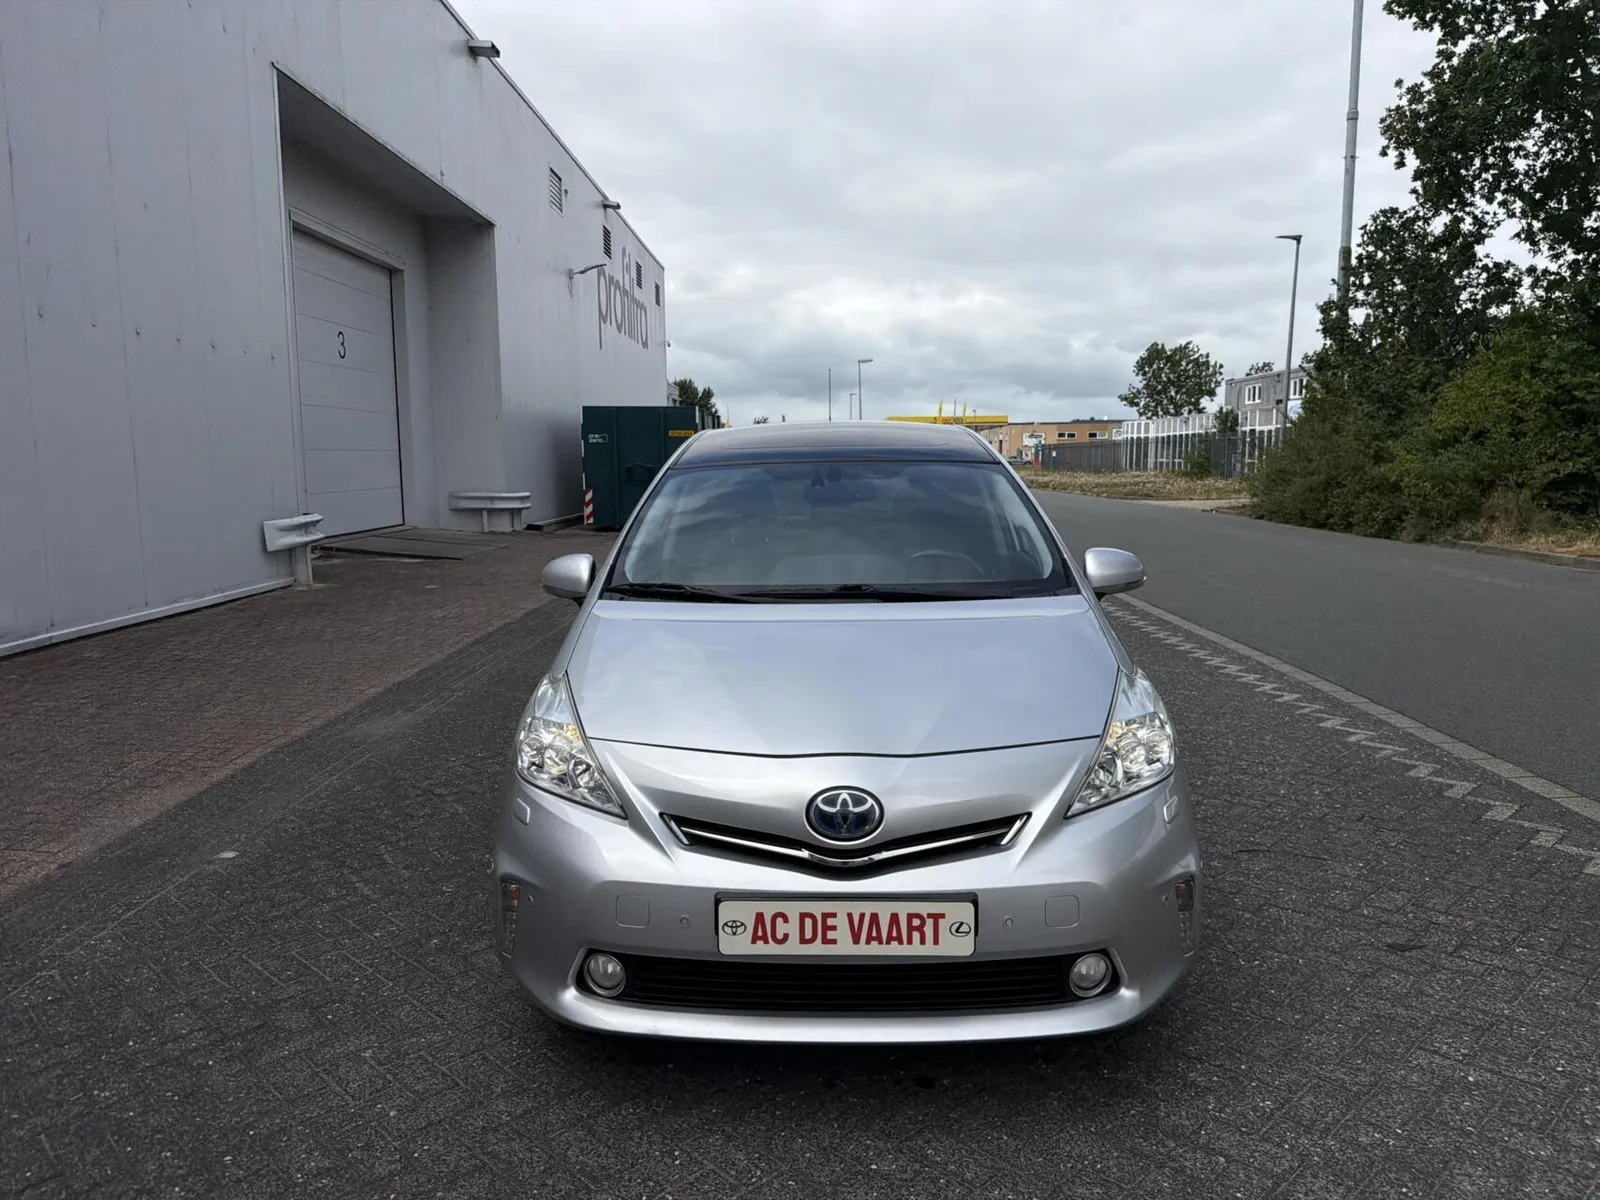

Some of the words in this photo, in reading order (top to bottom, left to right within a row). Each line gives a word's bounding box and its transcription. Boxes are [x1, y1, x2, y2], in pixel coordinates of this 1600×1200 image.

[597, 246, 649, 350] profiltra
[337, 331, 346, 359] 3
[750, 911, 789, 945] AC
[799, 912, 838, 945] DE
[846, 912, 946, 946] VAART
